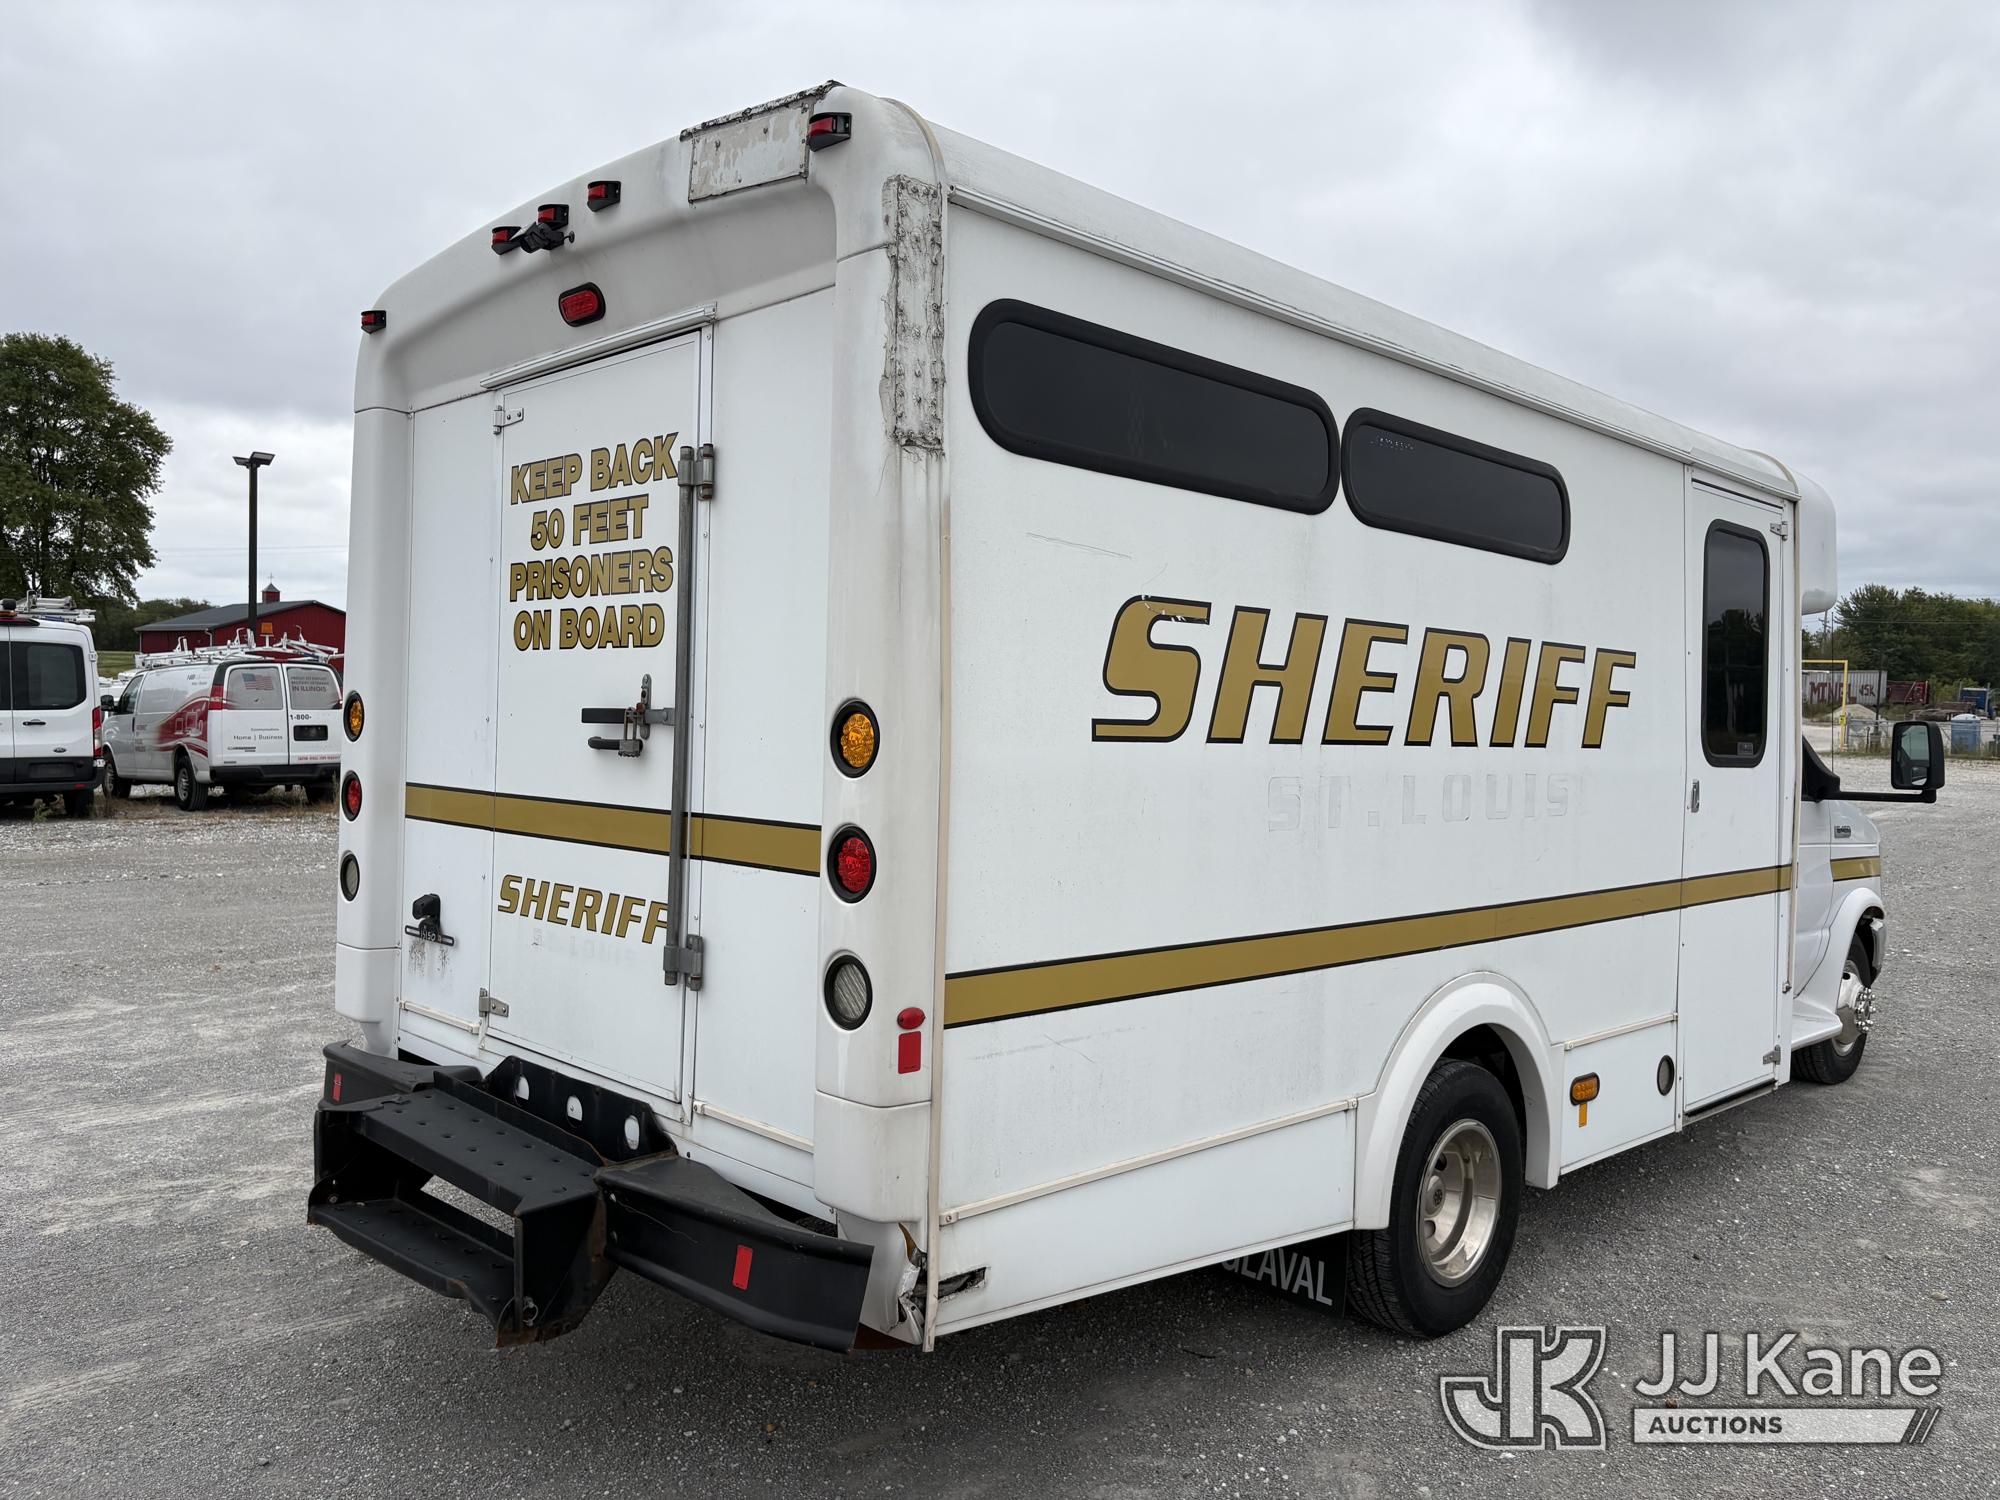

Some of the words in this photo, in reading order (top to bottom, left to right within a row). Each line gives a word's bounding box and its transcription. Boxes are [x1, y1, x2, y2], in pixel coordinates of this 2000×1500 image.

[511, 453, 582, 505] KEEP
[590, 431, 679, 491] BACK
[531, 508, 565, 551] 50
[573, 493, 649, 546] FEET
[510, 546, 674, 602] PRISONERS
[514, 609, 552, 652] ON
[559, 603, 666, 650] BOARD
[301, 685, 327, 693] ILLINOIS
[1091, 594, 1637, 750] SHERIFF
[1400, 772, 1570, 826] LOUIS
[498, 874, 669, 944] SHERIFF
